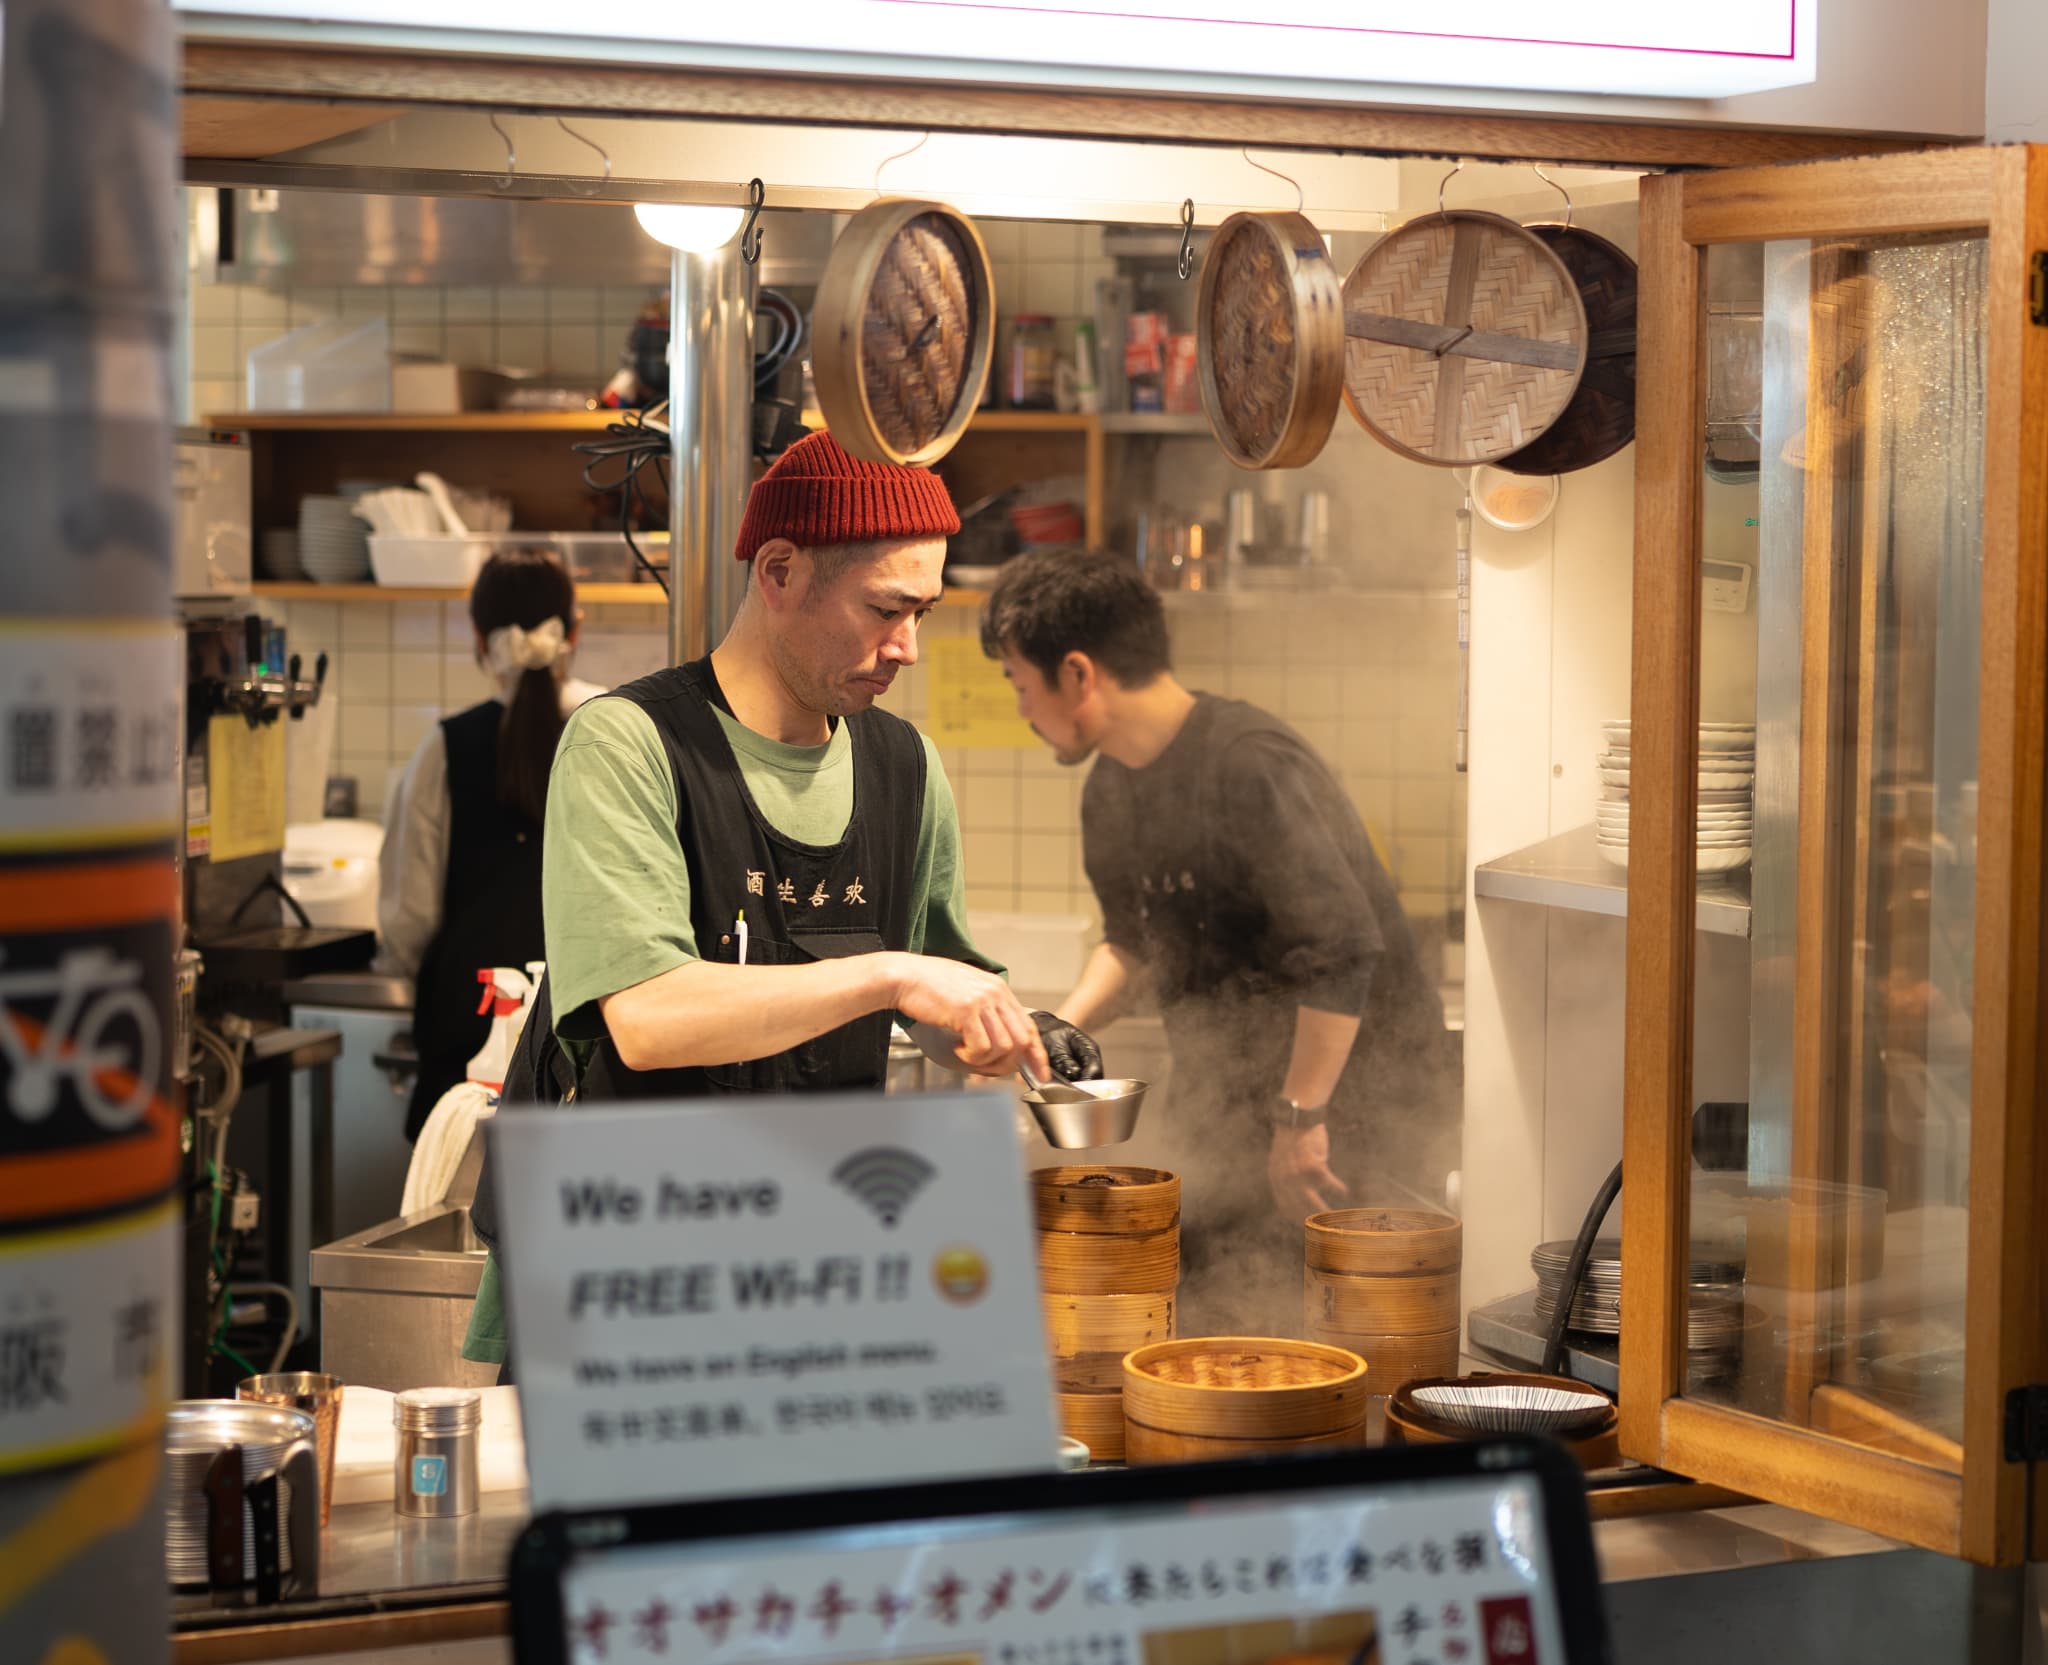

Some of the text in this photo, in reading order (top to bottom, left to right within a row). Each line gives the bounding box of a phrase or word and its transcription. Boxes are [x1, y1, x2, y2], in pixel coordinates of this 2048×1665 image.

[560, 1172, 781, 1227] We have
[569, 1263, 714, 1320] FREE
[731, 1256, 862, 1310] Wi-Fi
